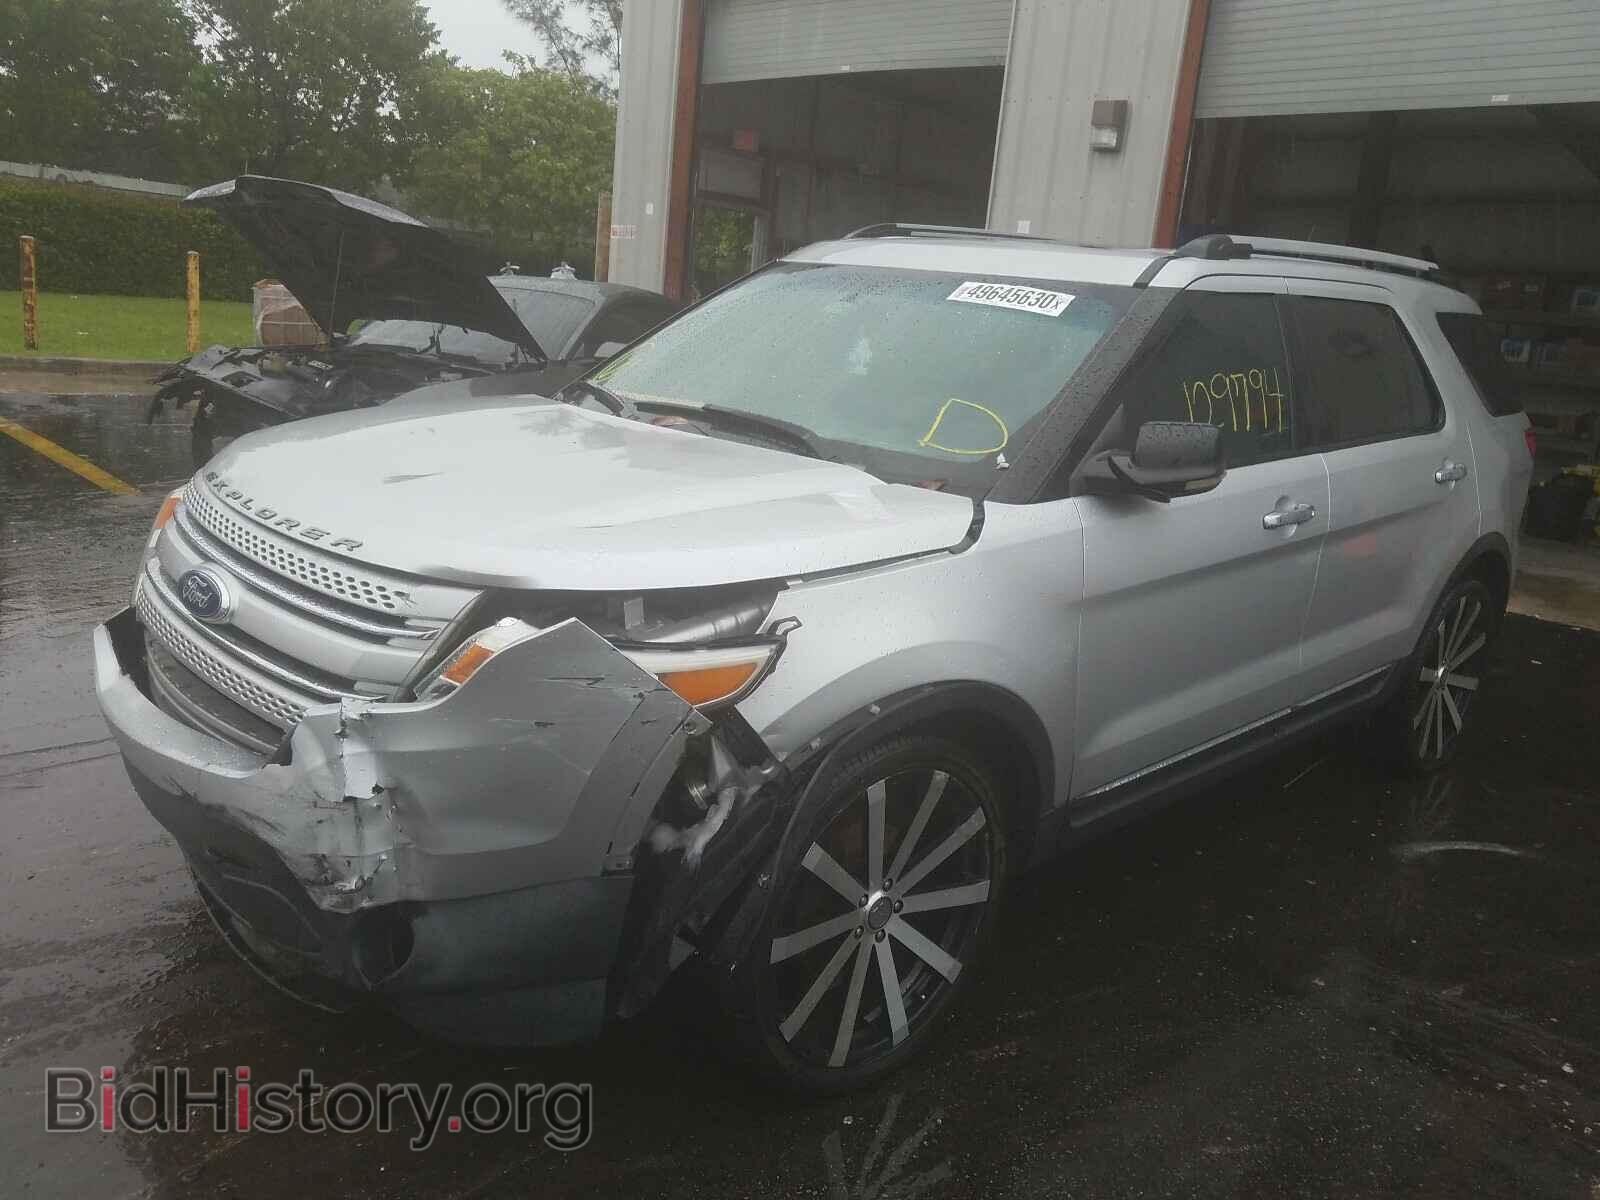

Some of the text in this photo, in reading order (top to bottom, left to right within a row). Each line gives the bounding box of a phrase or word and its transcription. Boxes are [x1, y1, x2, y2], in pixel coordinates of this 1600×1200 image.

[917, 398, 1008, 455] D
[206, 471, 364, 552] EXPLORER
[182, 575, 214, 609] Ford
